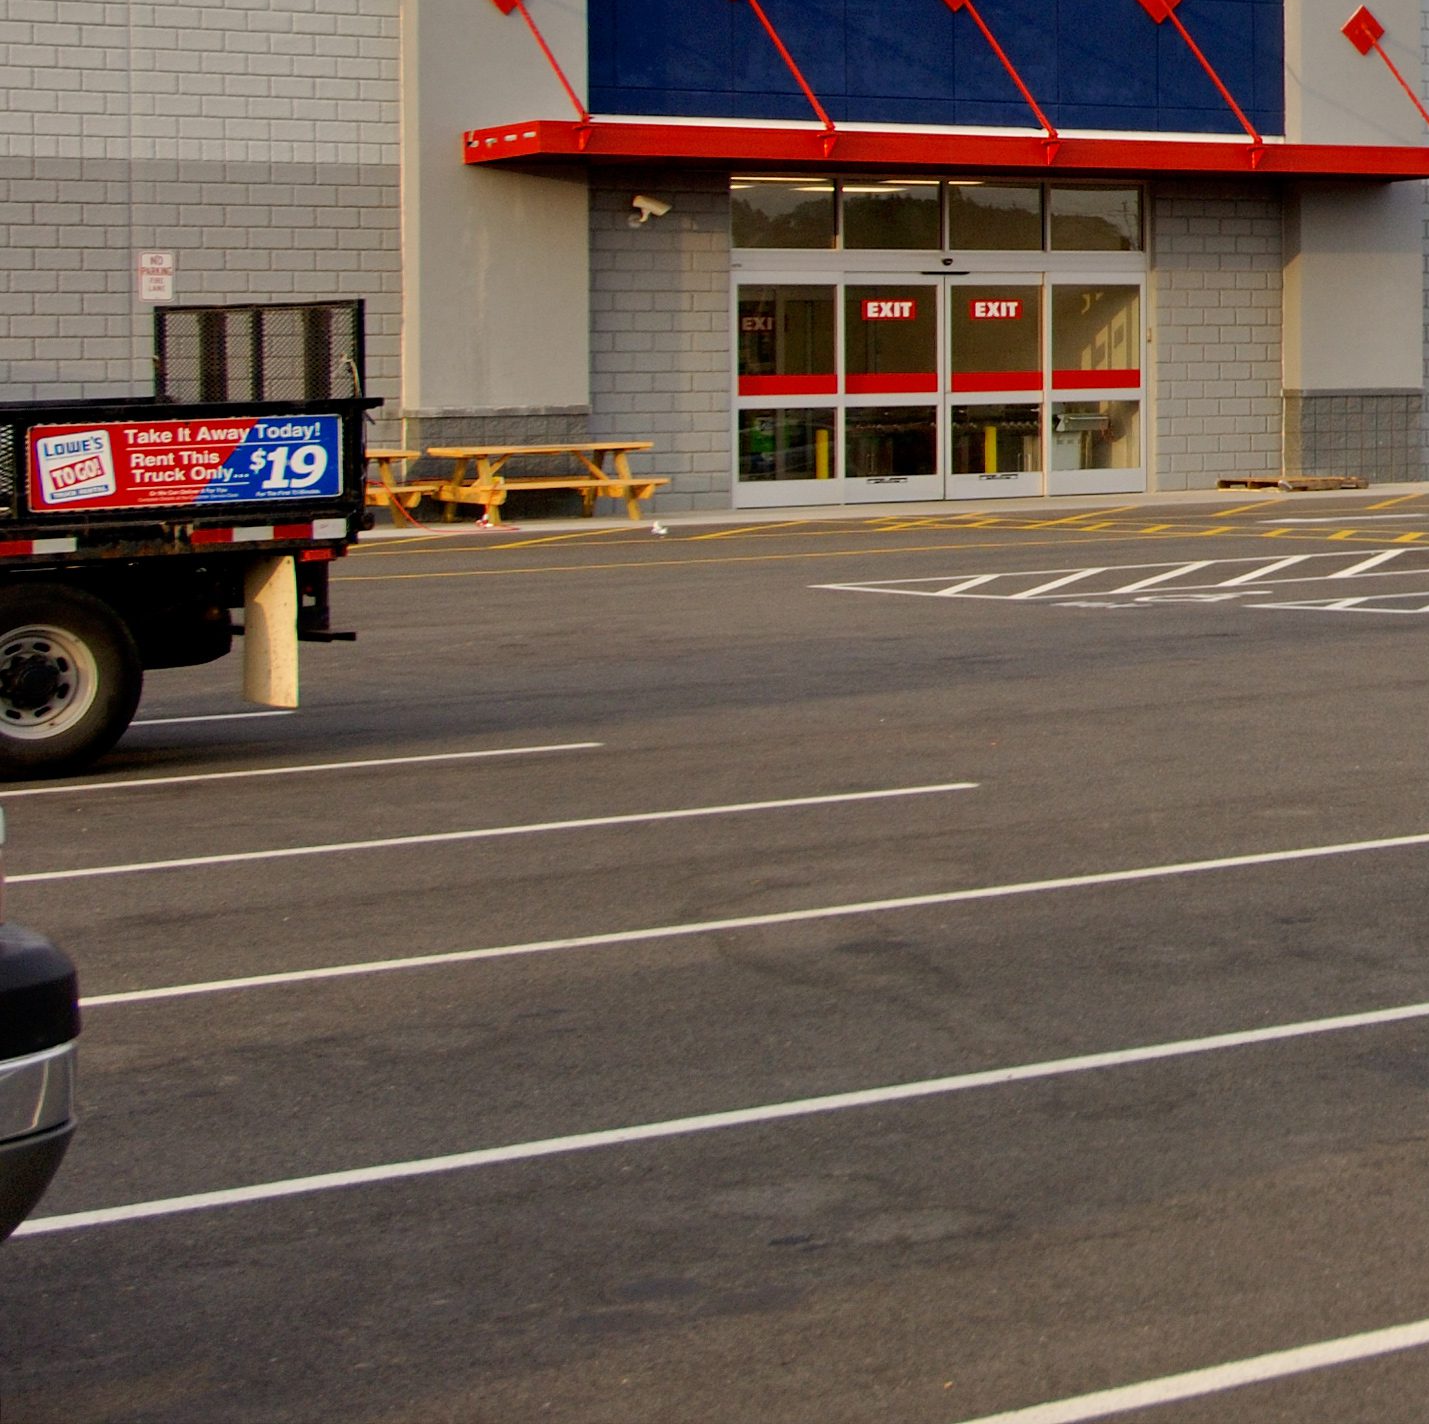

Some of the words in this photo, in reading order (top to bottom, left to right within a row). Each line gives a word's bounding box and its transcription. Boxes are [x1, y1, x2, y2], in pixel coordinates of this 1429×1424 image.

[150, 255, 164, 266] NO
[140, 266, 173, 276] PARKING
[866, 301, 912, 318] EXIT
[974, 301, 1018, 318] EXIT
[742, 317, 774, 332] EXI
[124, 429, 173, 445] Take
[178, 427, 191, 442] It
[196, 425, 250, 443] Away
[254, 422, 321, 440] Today!
[43, 436, 104, 458] LOWE'S
[130, 452, 175, 468] Rent
[179, 450, 220, 465] This
[249, 444, 328, 489] $19
[51, 465, 75, 488] TO
[74, 457, 102, 481] GO!
[131, 467, 187, 483] Truck
